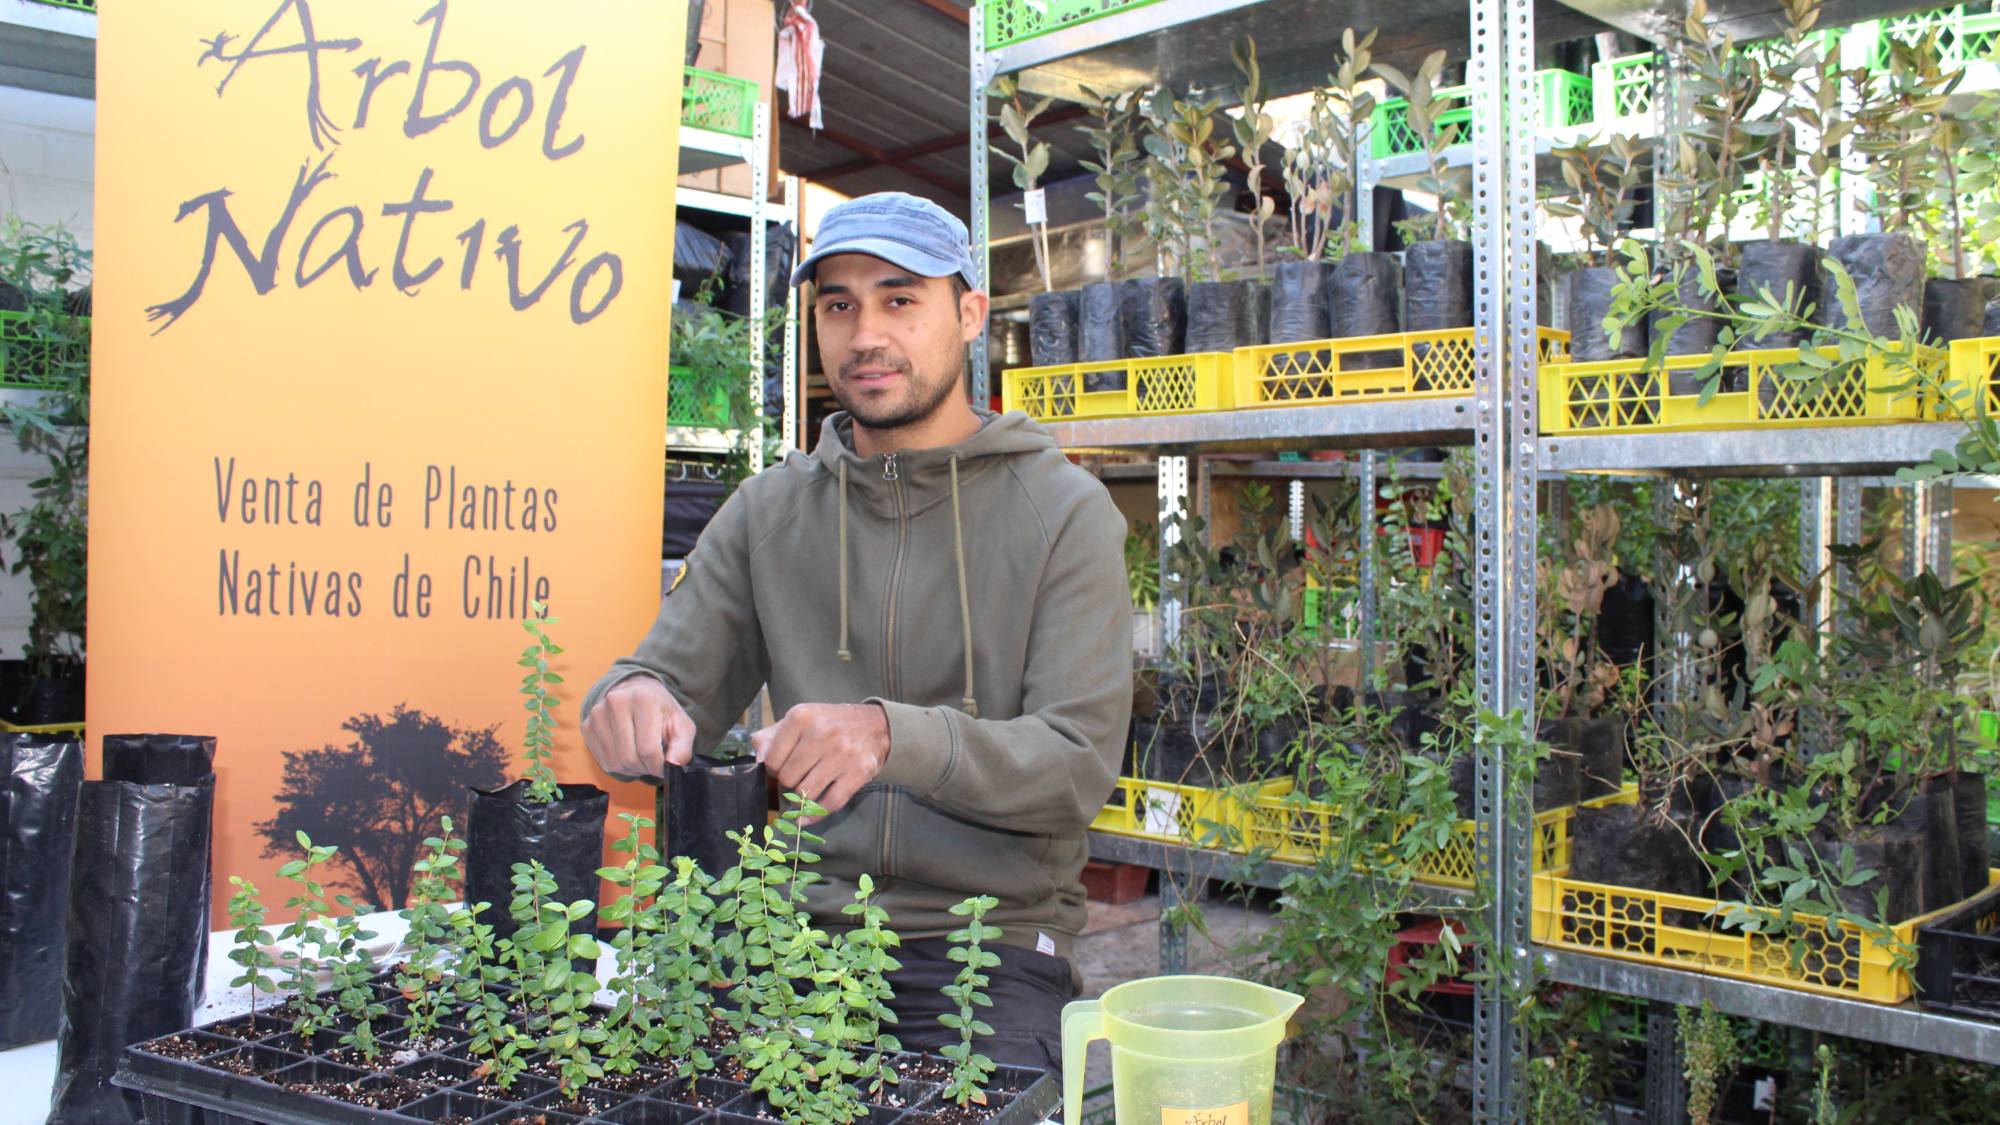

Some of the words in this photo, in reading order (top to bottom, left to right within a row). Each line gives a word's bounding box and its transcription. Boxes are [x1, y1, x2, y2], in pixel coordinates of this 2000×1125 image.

[144, 150, 623, 337] Nativo
[213, 456, 323, 527] Venta
[353, 461, 393, 528] de
[424, 464, 558, 532] Plantas
[218, 548, 362, 617] Nativas
[393, 552, 432, 619] de
[462, 554, 551, 620] Chile
